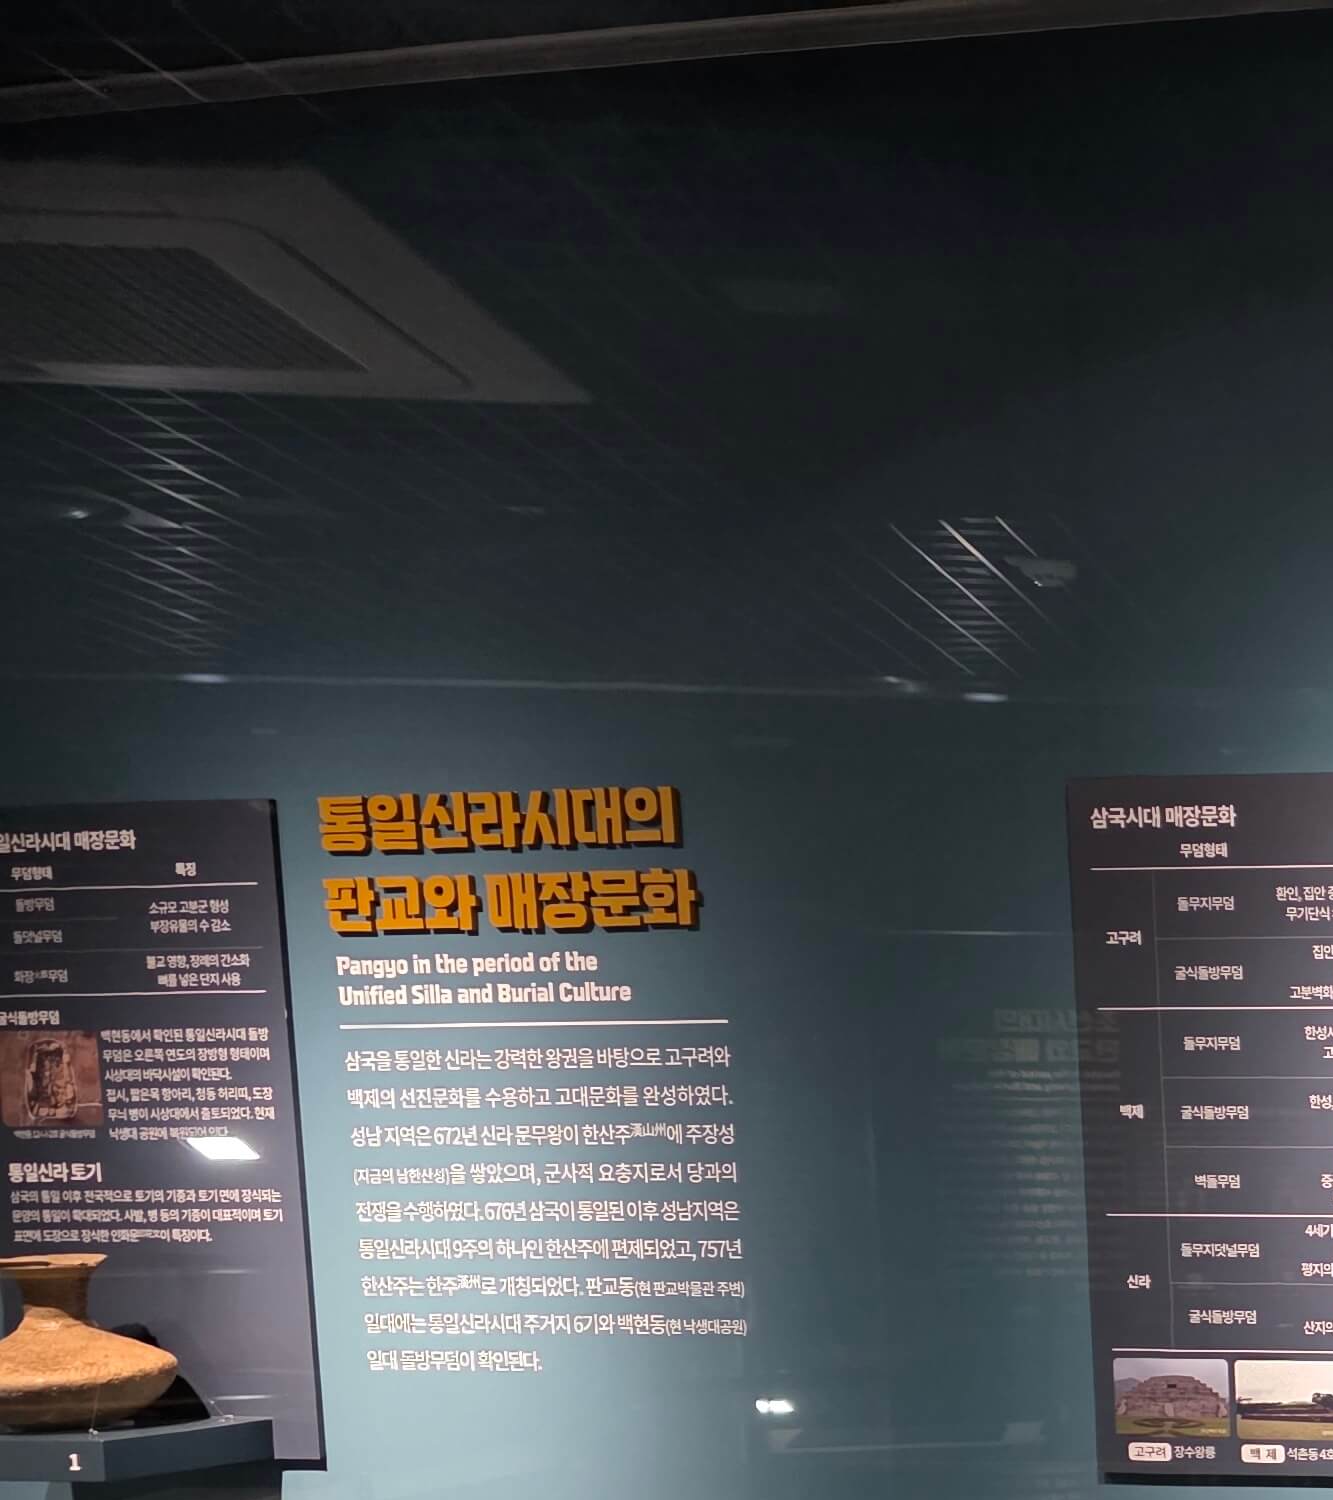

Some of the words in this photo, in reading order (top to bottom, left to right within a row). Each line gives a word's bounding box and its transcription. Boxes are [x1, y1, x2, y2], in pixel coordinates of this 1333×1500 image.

[318, 788, 678, 852] 통일신라시대의
[1091, 806, 1160, 828] 삼국시대
[1166, 805, 1236, 827] 매장문화
[74, 830, 136, 850] 매장문화
[1180, 843, 1227, 858] 무덤형태
[322, 873, 478, 932] 판교와
[485, 869, 696, 930] 매장문화
[1106, 931, 1141, 945] 고구려
[336, 957, 408, 978] Pangyo
[413, 954, 430, 973] in
[435, 954, 467, 973] the
[472, 952, 534, 976] period
[540, 952, 560, 971] of
[565, 951, 597, 971] the
[339, 985, 407, 1005] Unified
[412, 984, 452, 1004] Silla
[458, 983, 493, 1003] and
[497, 982, 554, 1002] Burial
[559, 982, 631, 1002] Culture
[345, 1051, 392, 1071] 삼국을
[394, 1050, 441, 1071] 통일한
[445, 1049, 492, 1070] 신라는
[495, 1048, 543, 1069] 강력한
[546, 1048, 594, 1069] 왕권을
[597, 1048, 662, 1068] 바탕으로
[665, 1046, 730, 1067] 고구려와
[347, 1088, 395, 1109] 백제의
[400, 1088, 481, 1108] 선진문화를
[485, 1087, 551, 1108] 수용하고
[555, 1086, 638, 1107] 고대문화를
[643, 1085, 732, 1106] 완성하였다.
[1120, 1104, 1143, 1118] 백제
[8, 1162, 69, 1182] 통일신라
[71, 1163, 101, 1182] 토기
[1127, 1275, 1151, 1288] 신라
[70, 1454, 80, 1470] 1
